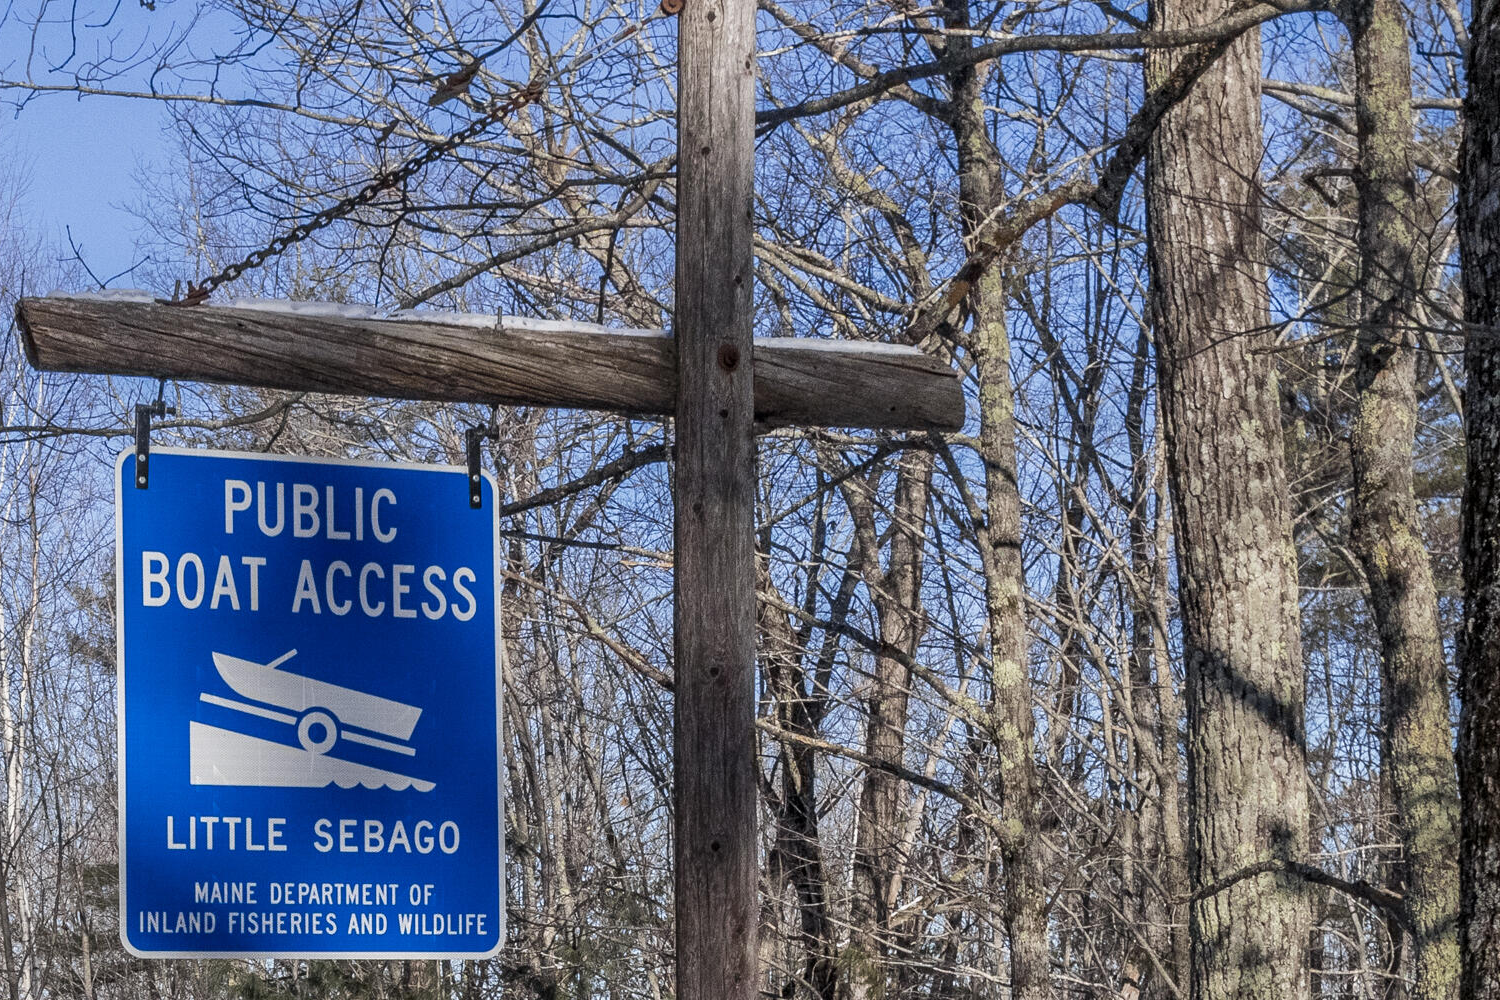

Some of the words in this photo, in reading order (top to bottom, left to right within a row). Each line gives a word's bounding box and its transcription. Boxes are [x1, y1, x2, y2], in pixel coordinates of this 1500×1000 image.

[225, 479, 397, 543] PUBLIC
[142, 550, 267, 612] BOAT
[291, 559, 477, 622] ACCESS
[167, 815, 288, 852] LITTLE
[313, 818, 460, 854] SEBAGO
[194, 882, 257, 905] MAINE
[270, 882, 399, 906] DEPARTMENT
[409, 883, 435, 906] OF
[139, 911, 216, 934] INLAND
[228, 912, 338, 935] FISHERIES
[347, 912, 388, 936] AND
[398, 913, 488, 936] WILDLIFE
